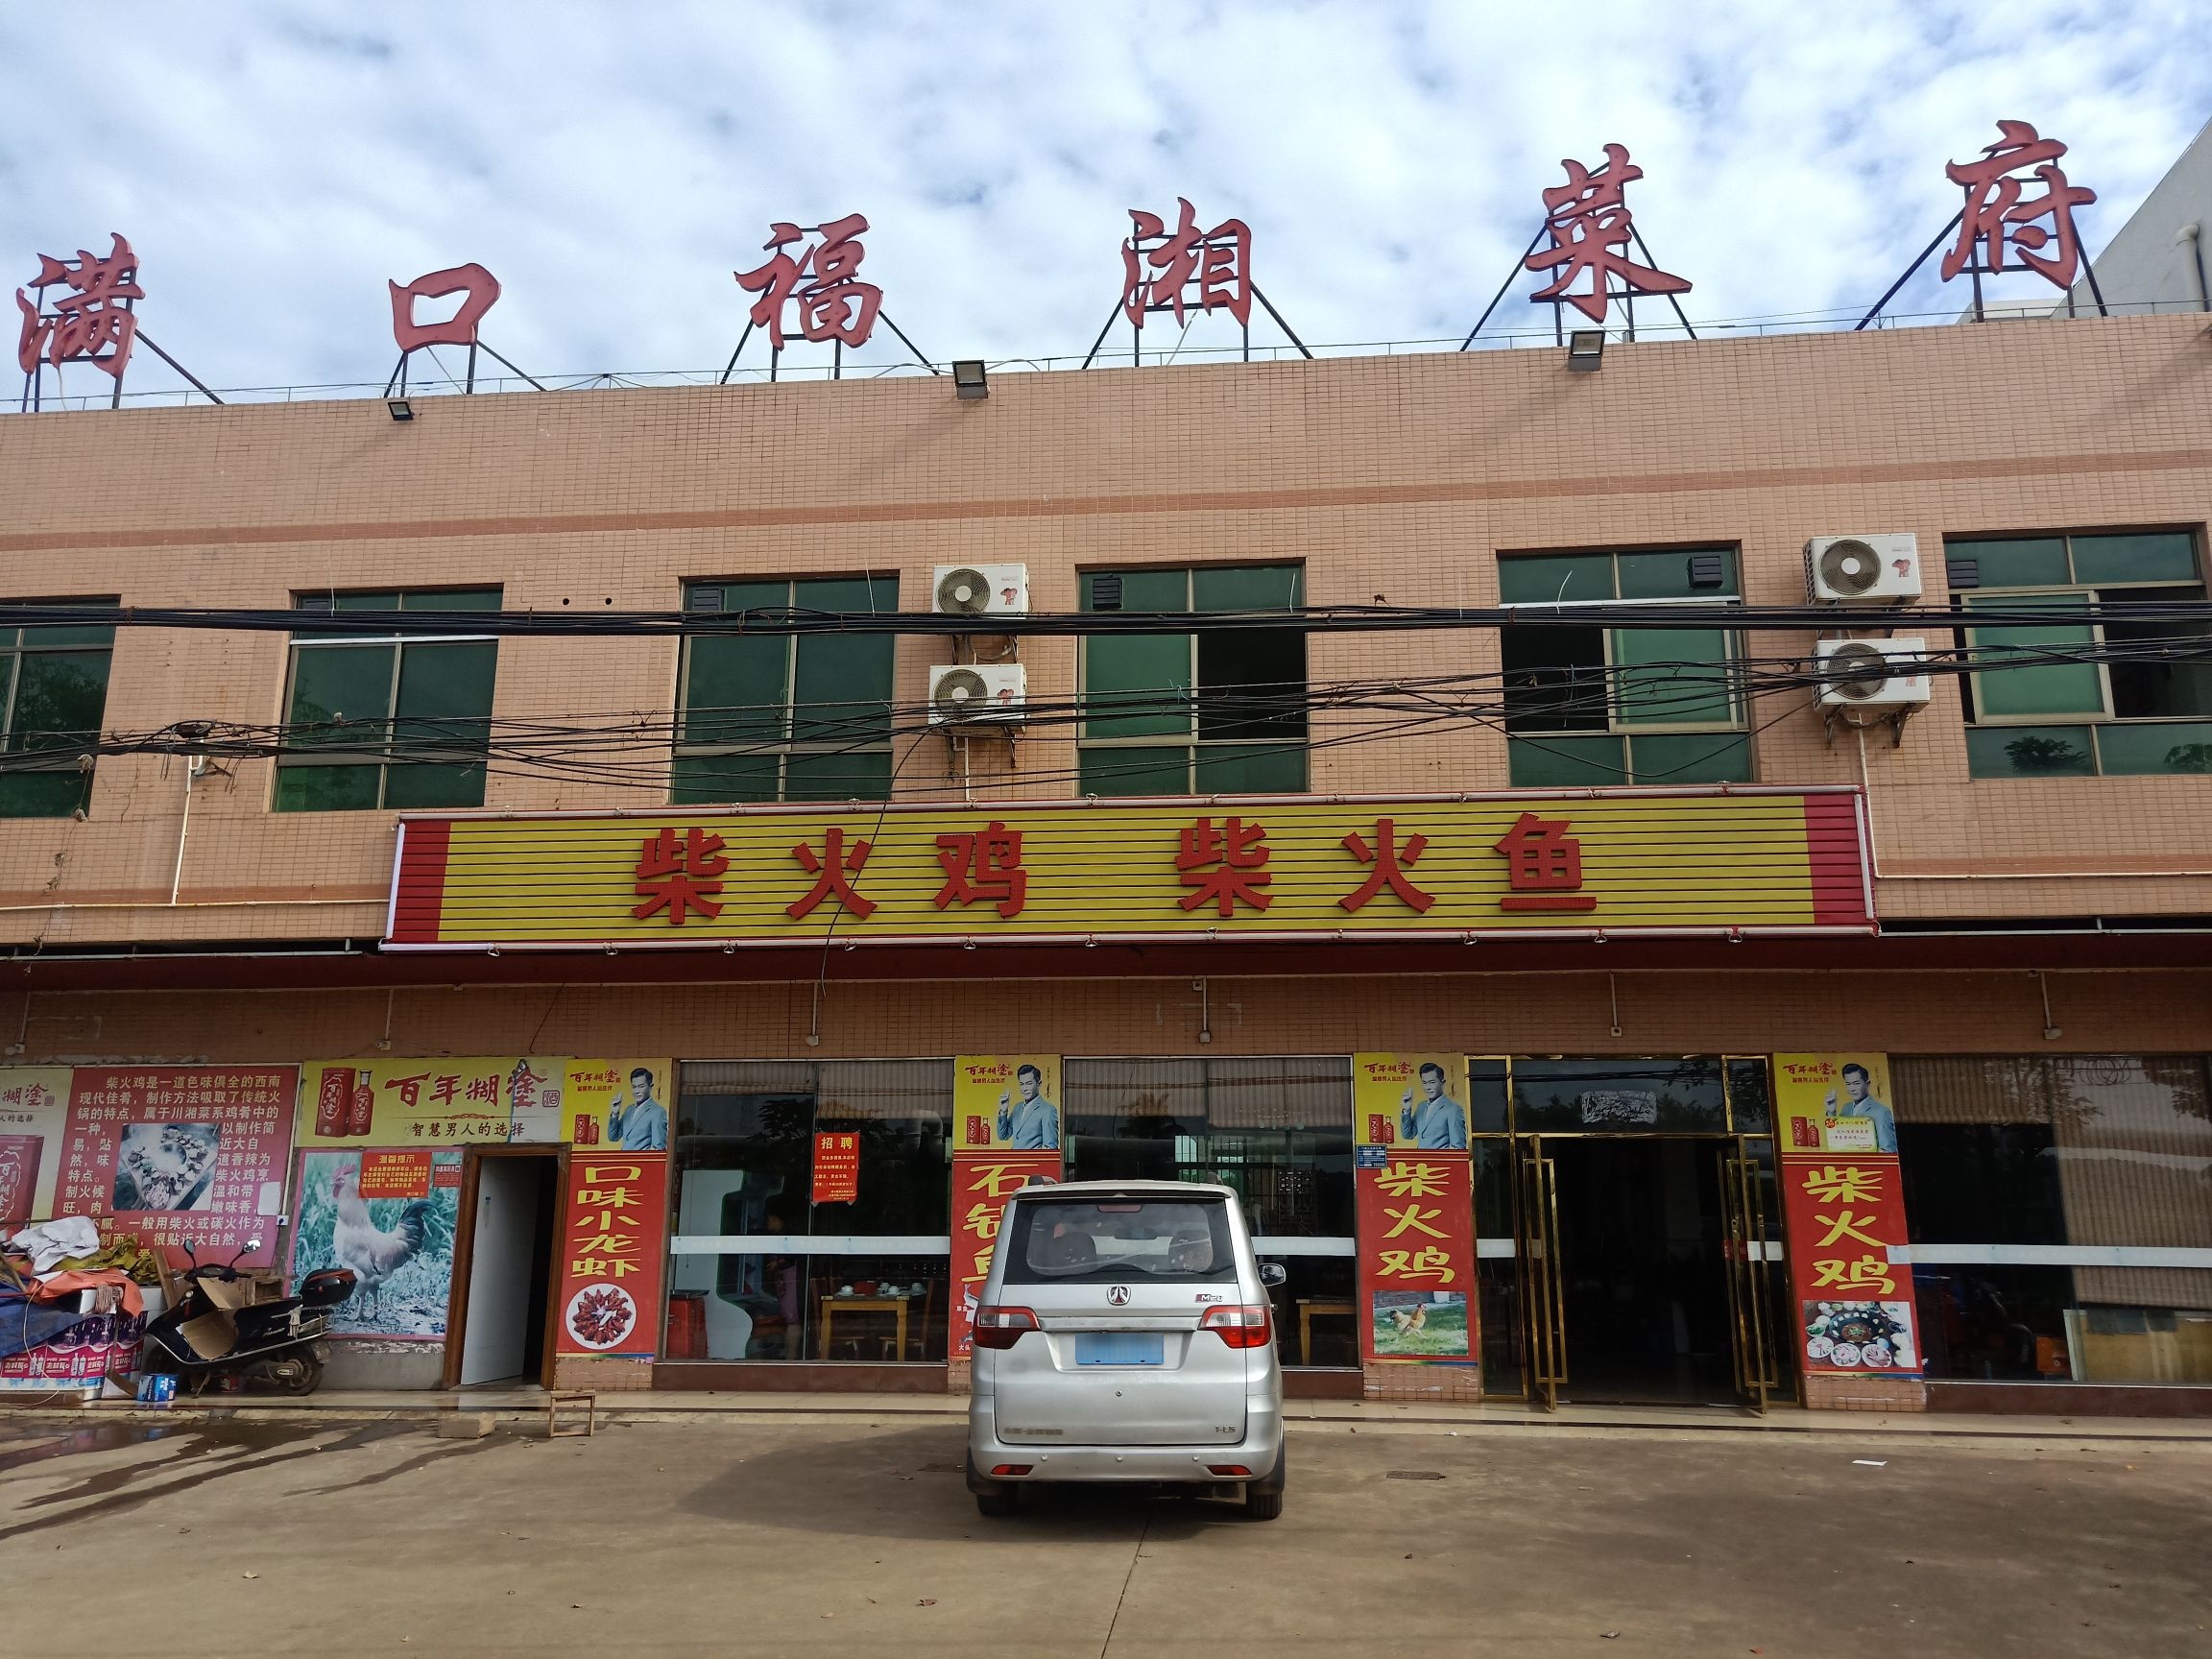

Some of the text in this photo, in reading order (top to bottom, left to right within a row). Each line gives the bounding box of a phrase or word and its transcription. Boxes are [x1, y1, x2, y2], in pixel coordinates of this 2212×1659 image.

[16, 119, 2098, 377] 满口福湘菜府
[630, 812, 1598, 925] 柴火鸡 柴火鱼
[106, 1074, 281, 1090] 柴火鸡是一道色味俱全的西南
[222, 1121, 276, 1136] 以制作简
[412, 1121, 526, 1138] 智慧男人的选择
[219, 1137, 260, 1151] 近大自
[217, 1152, 271, 1167] 道香辣为
[215, 1167, 269, 1182] 柴火鸡烹
[65, 1184, 253, 1199] 制火候 温和带
[570, 1165, 644, 1279] 口味小龙虾
[1374, 1162, 1455, 1284] 柴火鸡
[1802, 1166, 1897, 1295] 柴火鸡
